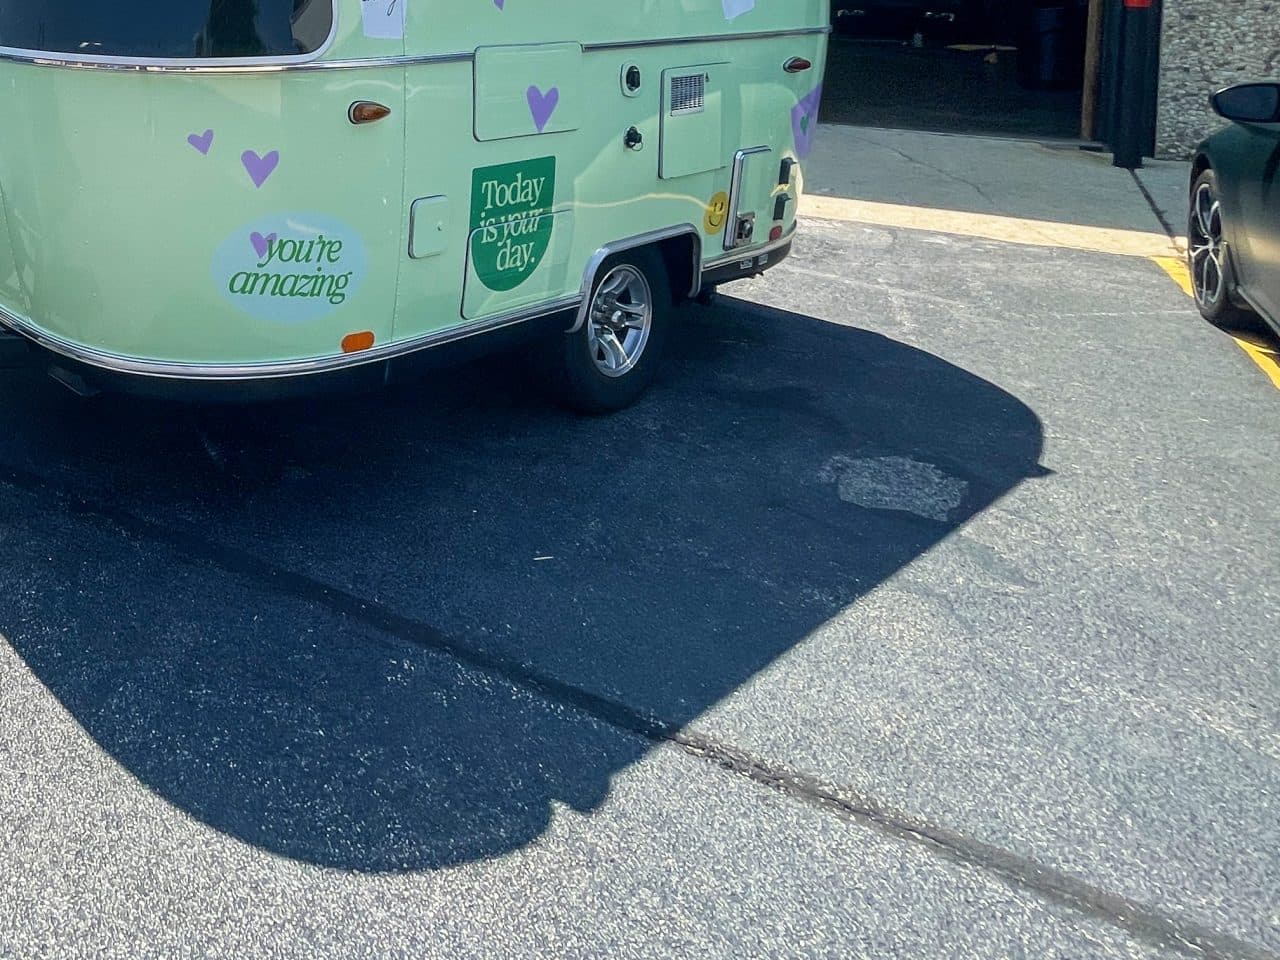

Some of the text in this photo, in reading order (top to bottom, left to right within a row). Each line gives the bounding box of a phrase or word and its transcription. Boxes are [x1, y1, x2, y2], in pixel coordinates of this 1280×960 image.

[481, 172, 545, 210] Today
[480, 208, 544, 246] is your
[257, 234, 342, 268] you're
[496, 239, 535, 272] day.
[229, 267, 352, 304] amazing
